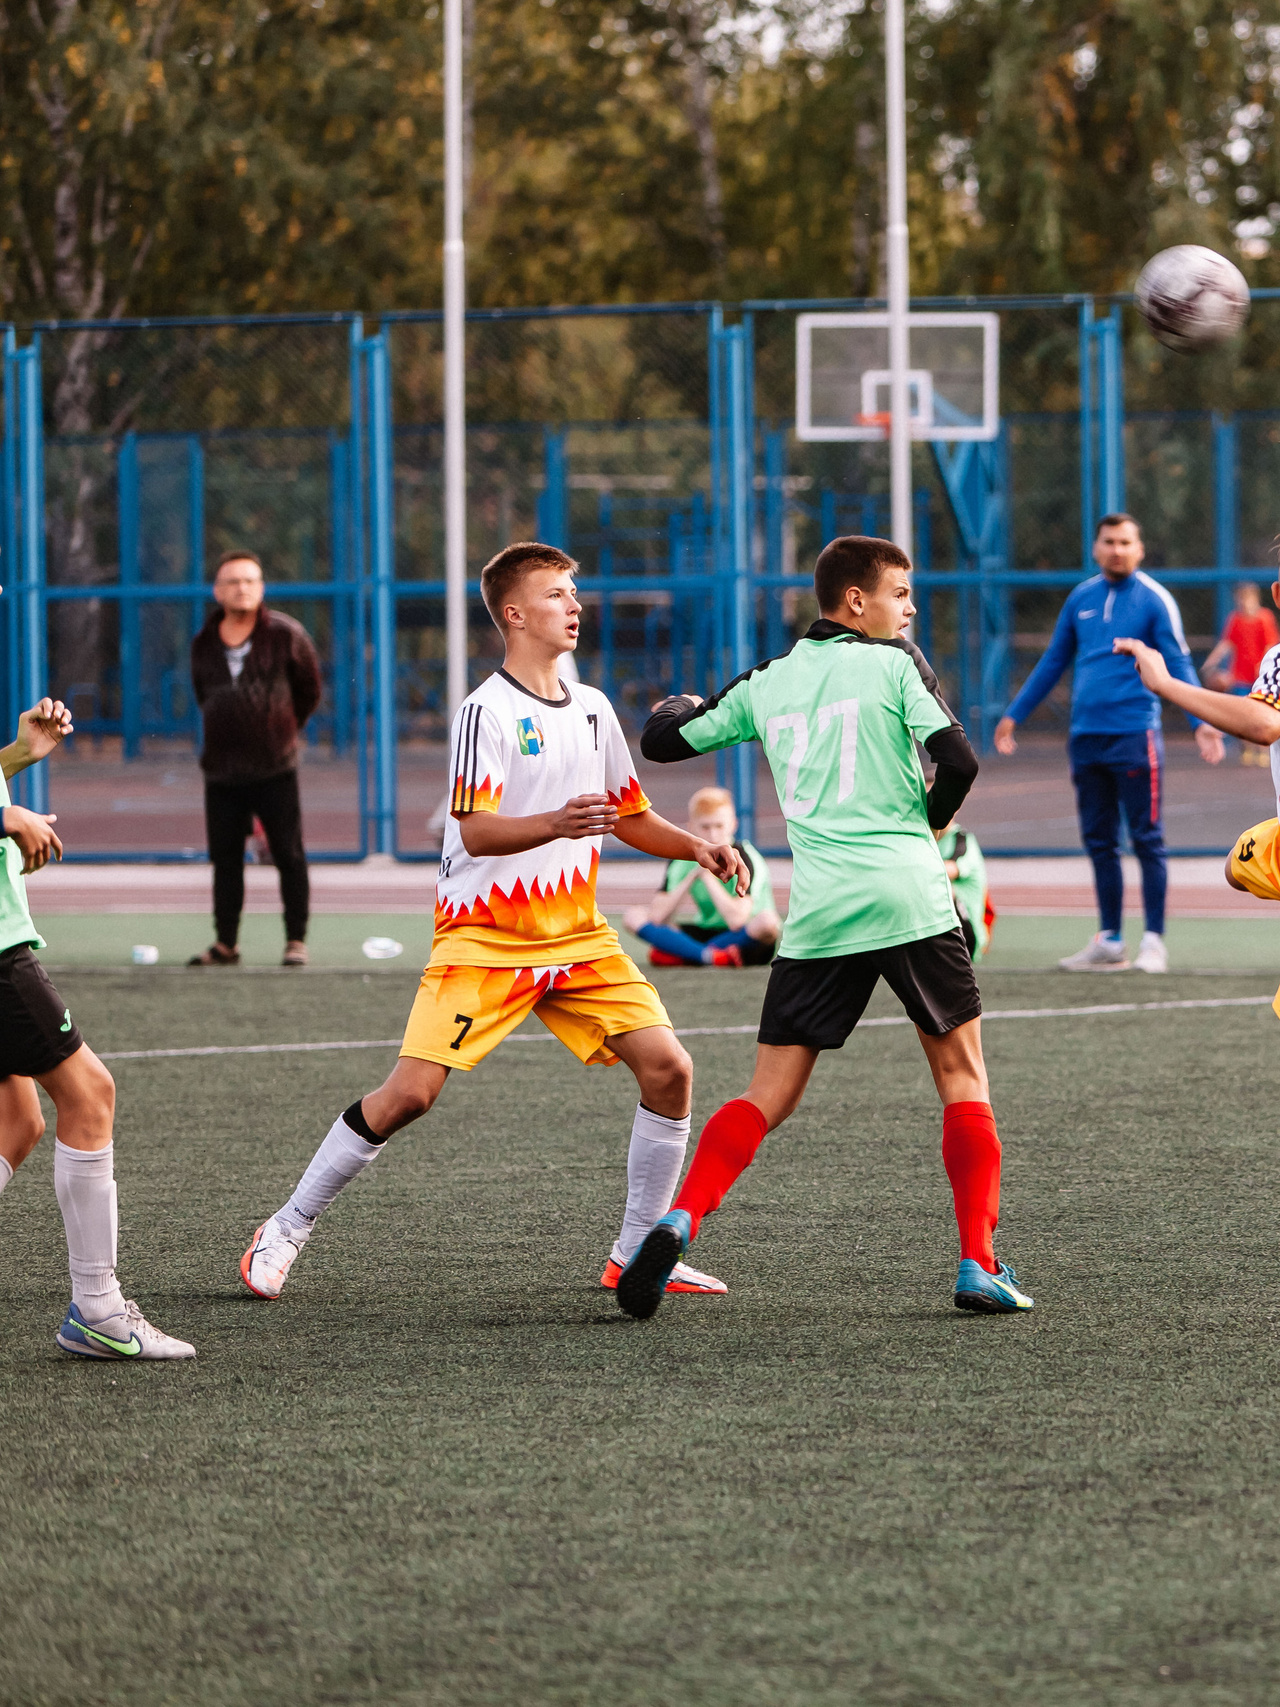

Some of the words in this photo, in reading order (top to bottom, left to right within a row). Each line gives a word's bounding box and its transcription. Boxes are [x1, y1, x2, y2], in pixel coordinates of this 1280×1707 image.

[586, 713, 598, 751] 7
[766, 698, 858, 820] 27
[450, 1013, 474, 1051] 7
